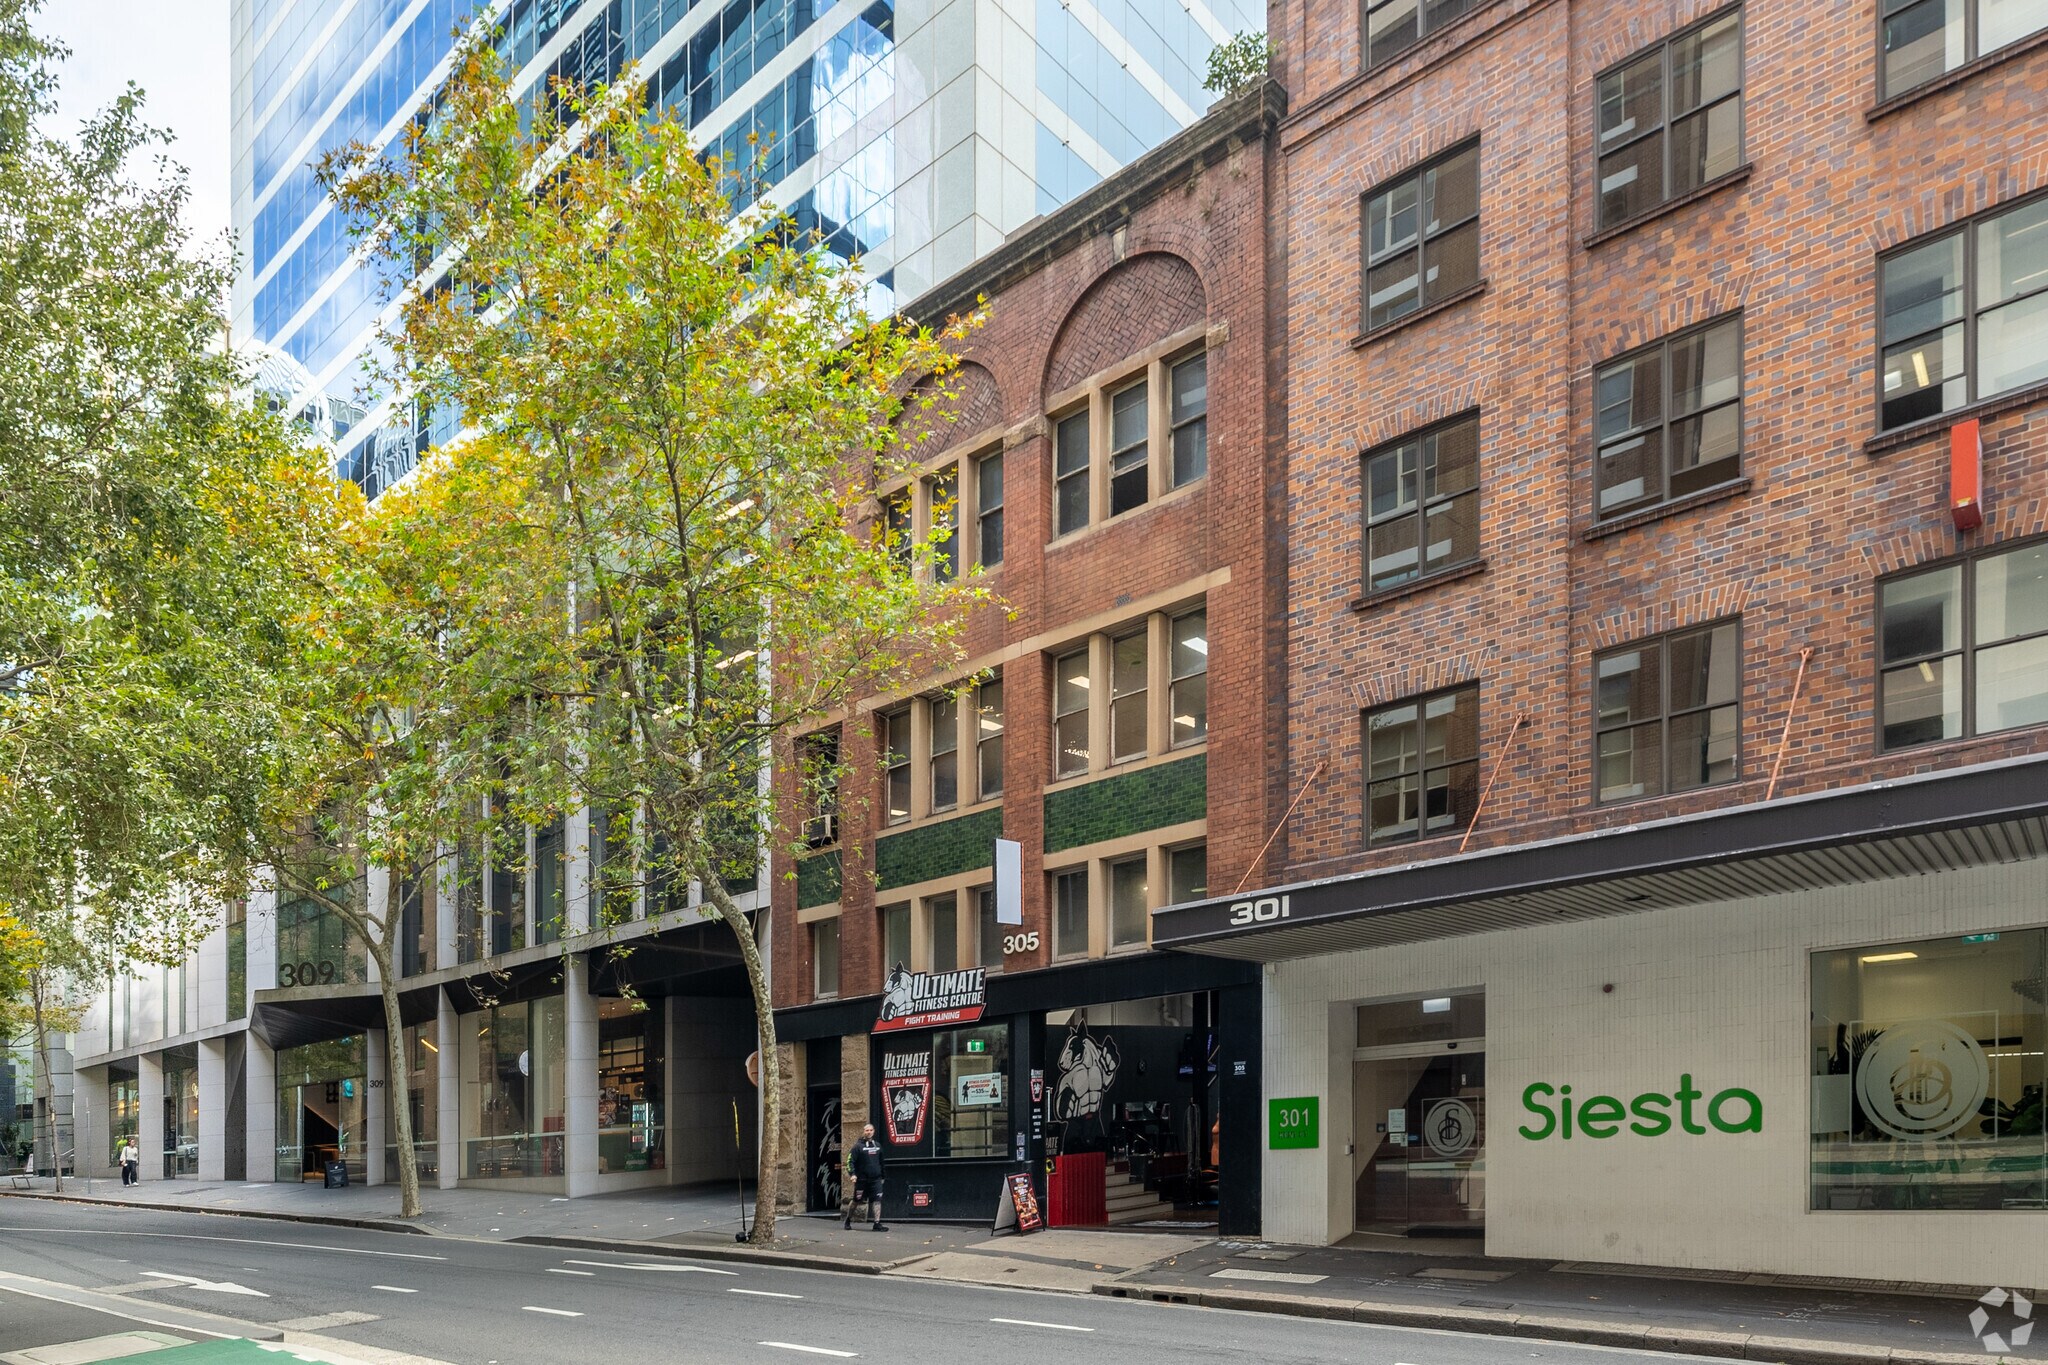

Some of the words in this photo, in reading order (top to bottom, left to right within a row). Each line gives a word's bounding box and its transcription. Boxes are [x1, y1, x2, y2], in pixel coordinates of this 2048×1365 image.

[1230, 895, 1289, 925] 301
[1003, 931, 1040, 955] 305
[279, 960, 335, 988] 309
[912, 968, 985, 1000] ULTIMATE
[914, 994, 948, 1012] FITNESS
[949, 991, 983, 1007] CENTRE
[904, 1016, 925, 1026] FIGHT
[926, 1011, 960, 1022] TRAINING
[883, 1052, 930, 1071] ULTIMATE
[884, 1069, 907, 1079] FITNESS
[907, 1066, 928, 1077] CENTRE
[369, 1080, 385, 1088] 309
[1279, 1108, 1309, 1127] 301
[1518, 1073, 1763, 1141] Siesta
